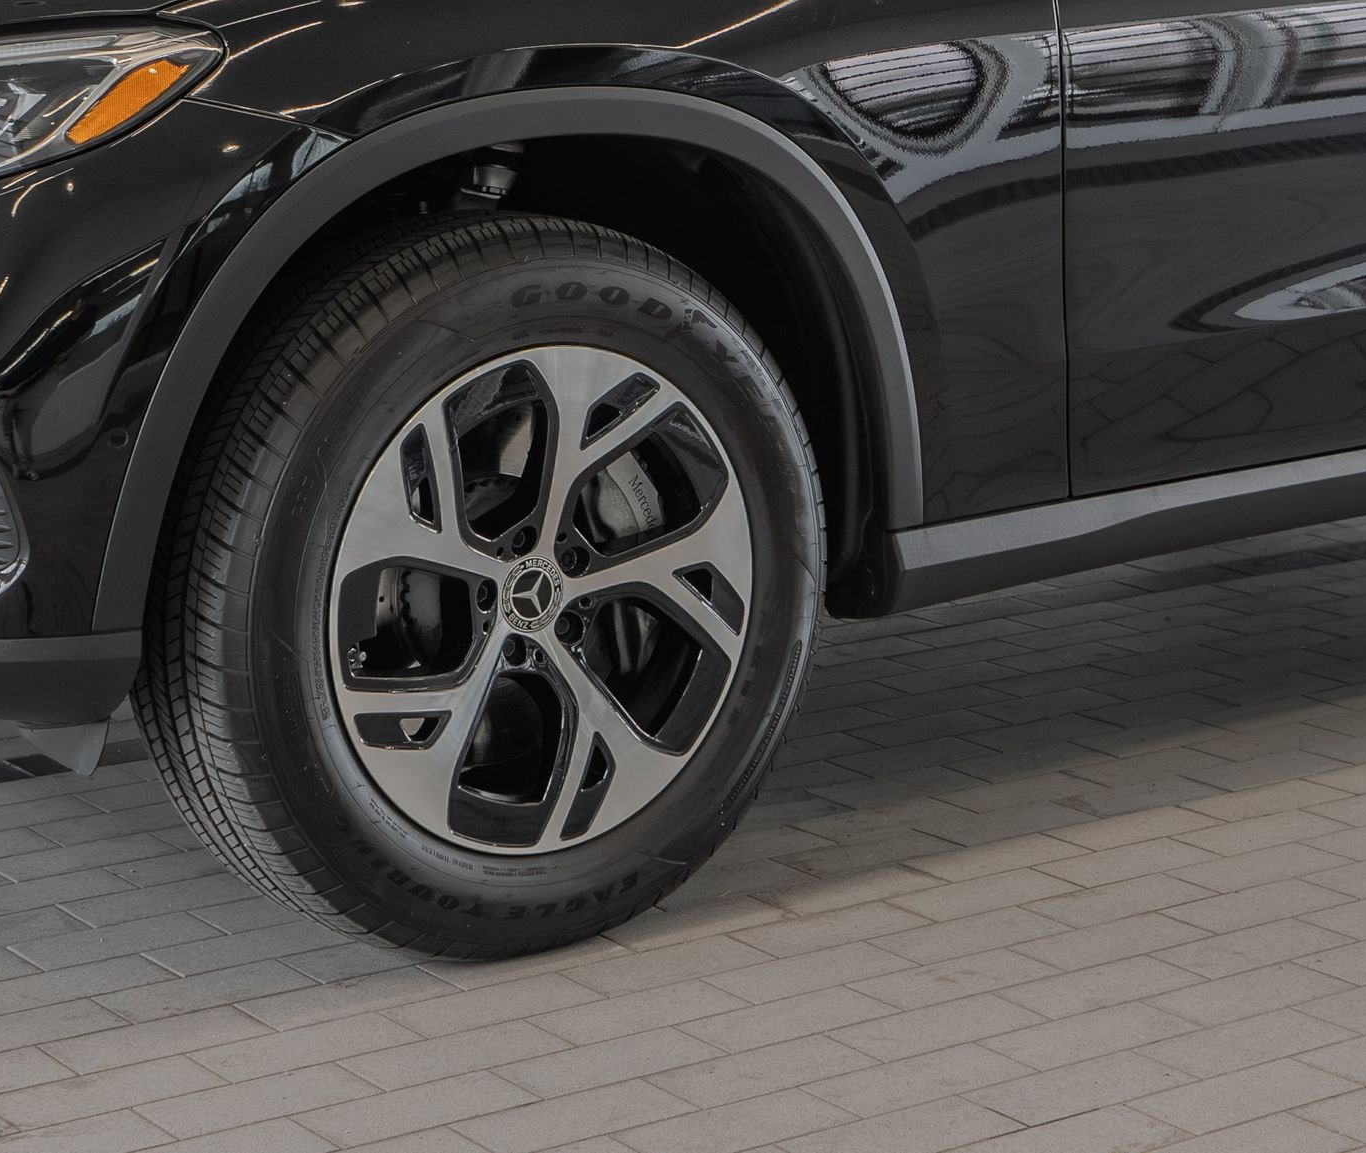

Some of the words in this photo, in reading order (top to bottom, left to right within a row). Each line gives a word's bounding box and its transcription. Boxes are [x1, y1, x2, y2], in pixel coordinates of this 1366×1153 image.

[525, 559, 561, 587] MERCEDES
[508, 613, 530, 629] BENZ
[508, 871, 639, 921] EAGLE
